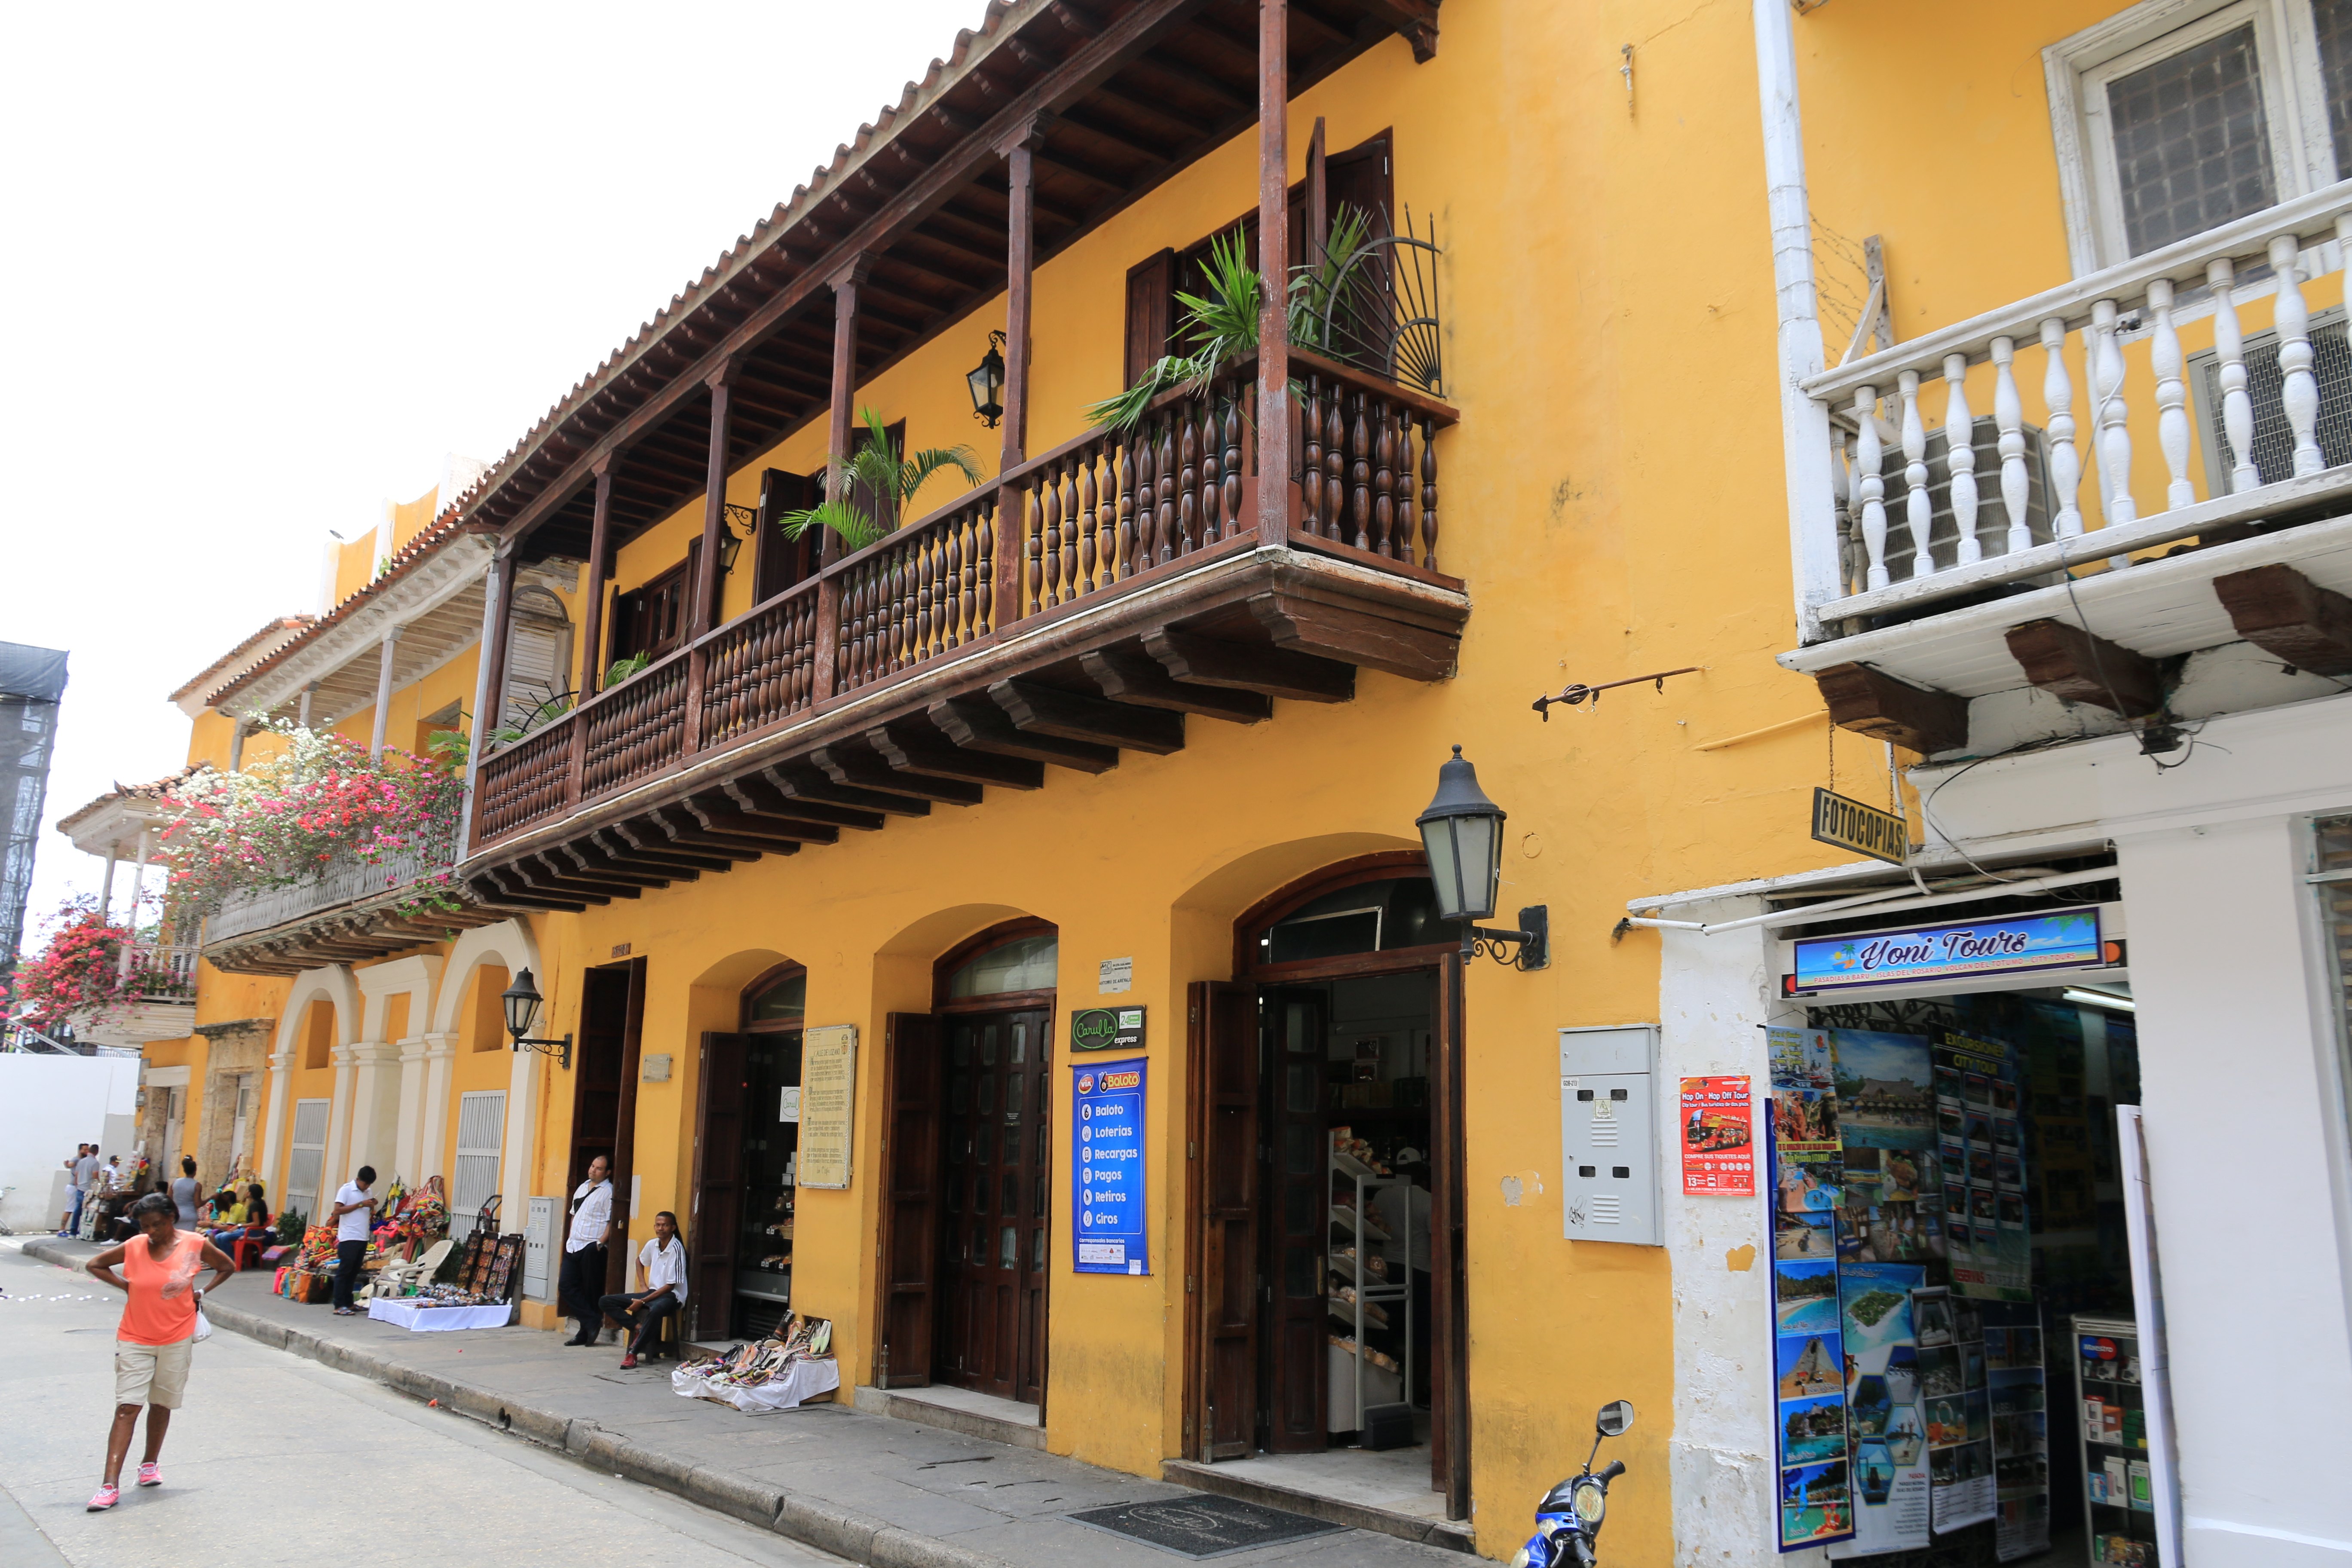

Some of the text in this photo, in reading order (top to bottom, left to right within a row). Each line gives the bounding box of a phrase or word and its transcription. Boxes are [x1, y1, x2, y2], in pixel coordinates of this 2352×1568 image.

[1822, 796, 1903, 858] FOTOCOPIAS
[1860, 931, 2028, 969] Yoni Tours
[1912, 966, 1942, 974] ROSARIO
[1945, 963, 1972, 971] VOLCAN
[1992, 958, 2024, 967] TOTUMO
[2032, 955, 2048, 963] CITY
[2050, 952, 2076, 962] TOURS
[1120, 1015, 1129, 1026] 24
[1077, 1018, 1115, 1038] Carulla
[1114, 1036, 1138, 1046] express
[1944, 1032, 2004, 1058] EXCURSIONES
[1953, 1054, 1999, 1076] CITY TOUR
[1108, 1074, 1139, 1087] Baloto
[1682, 1093, 1694, 1101] Hop
[1695, 1092, 1704, 1100] On
[1709, 1092, 1721, 1100] Hop
[1722, 1091, 1732, 1099] Off
[1733, 1091, 1749, 1099] Tour
[1096, 1104, 1124, 1116] Baloto
[1095, 1125, 1133, 1138] Loterías
[1095, 1148, 1138, 1161] Recargas
[1095, 1170, 1122, 1183] Pagos
[1687, 1177, 1697, 1187] 13
[1095, 1190, 1127, 1202] Retiros
[1096, 1212, 1118, 1225] Giros
[2083, 1343, 2114, 1352] Maestro
